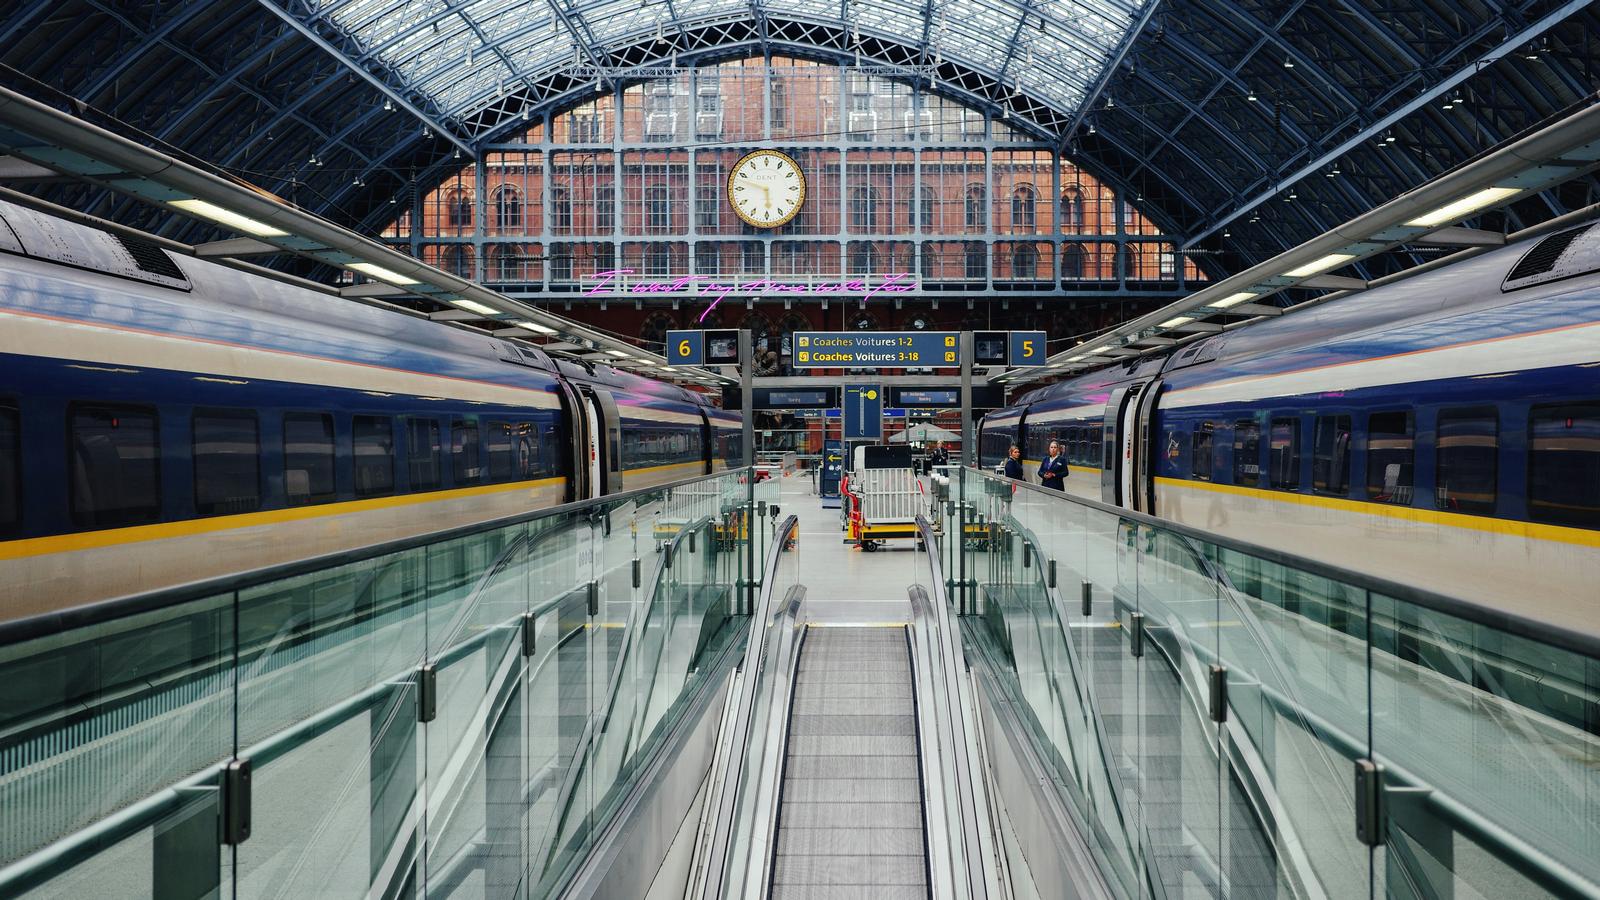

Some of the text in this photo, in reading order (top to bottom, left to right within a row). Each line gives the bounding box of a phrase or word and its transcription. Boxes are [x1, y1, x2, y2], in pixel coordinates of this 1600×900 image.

[583, 270, 634, 296] I
[679, 340, 691, 357] 6
[813, 337, 913, 346] Coaches Voitures 1-2
[1023, 341, 1034, 358] 5
[813, 352, 919, 361] Coaches Voitures 3-18
